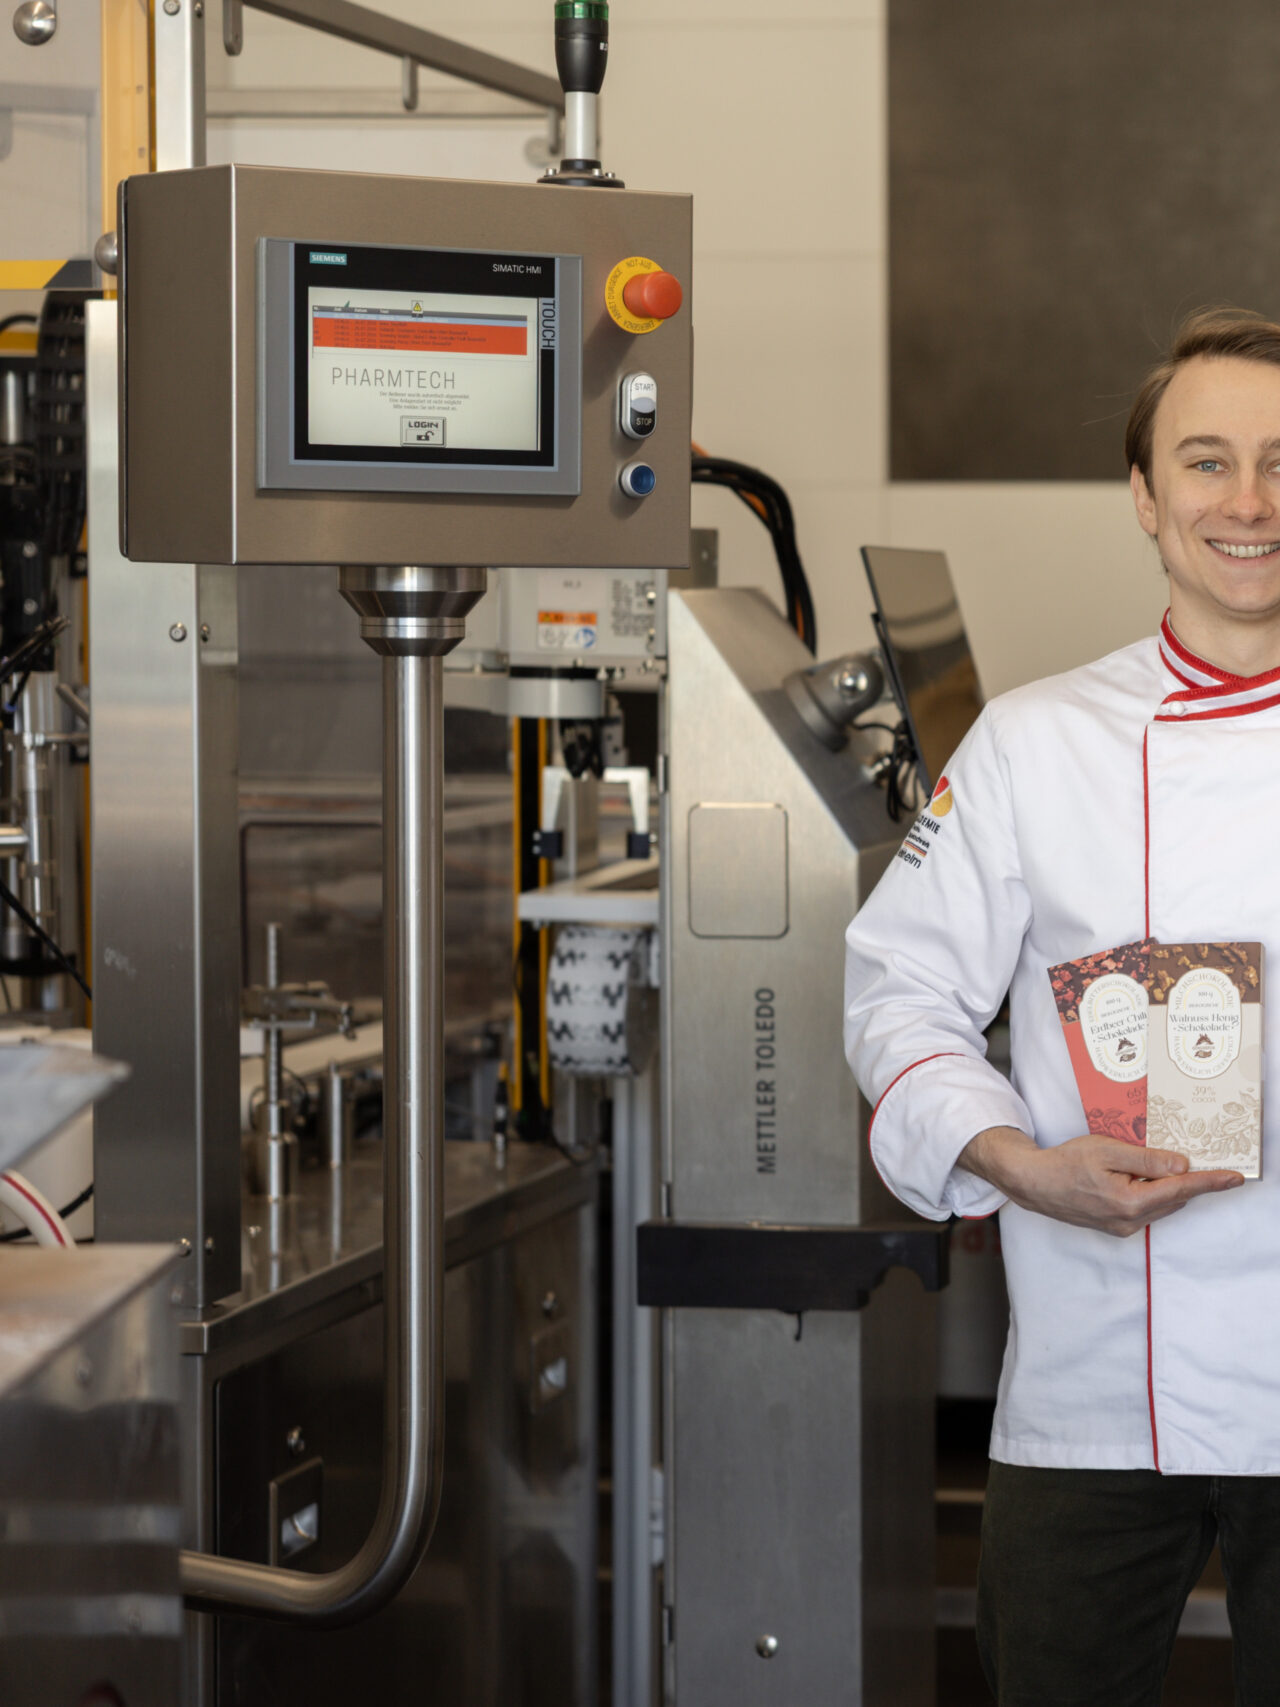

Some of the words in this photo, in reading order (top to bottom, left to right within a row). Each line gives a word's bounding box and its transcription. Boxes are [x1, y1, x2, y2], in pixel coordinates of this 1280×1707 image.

[311, 253, 346, 263] SIEMENS
[492, 263, 525, 274] SIMATIC
[526, 264, 542, 275] HMI
[541, 300, 556, 349] TOUCH
[331, 367, 456, 389] PHARMTECH
[634, 382, 654, 392] START
[408, 420, 439, 429] LOGIN
[635, 417, 653, 426] STOP
[1090, 1017, 1124, 1036] Erdbeer
[1126, 1011, 1147, 1023] Chili
[1169, 1014, 1210, 1023] Walnuss
[1211, 1013, 1240, 1027] Honig
[754, 987, 776, 1071] TOLEDO
[1097, 1023, 1146, 1042] Schokolade
[1177, 1022, 1231, 1032] Schokolade
[1191, 1085, 1217, 1097] 39%
[755, 1080, 777, 1175] METTLER
